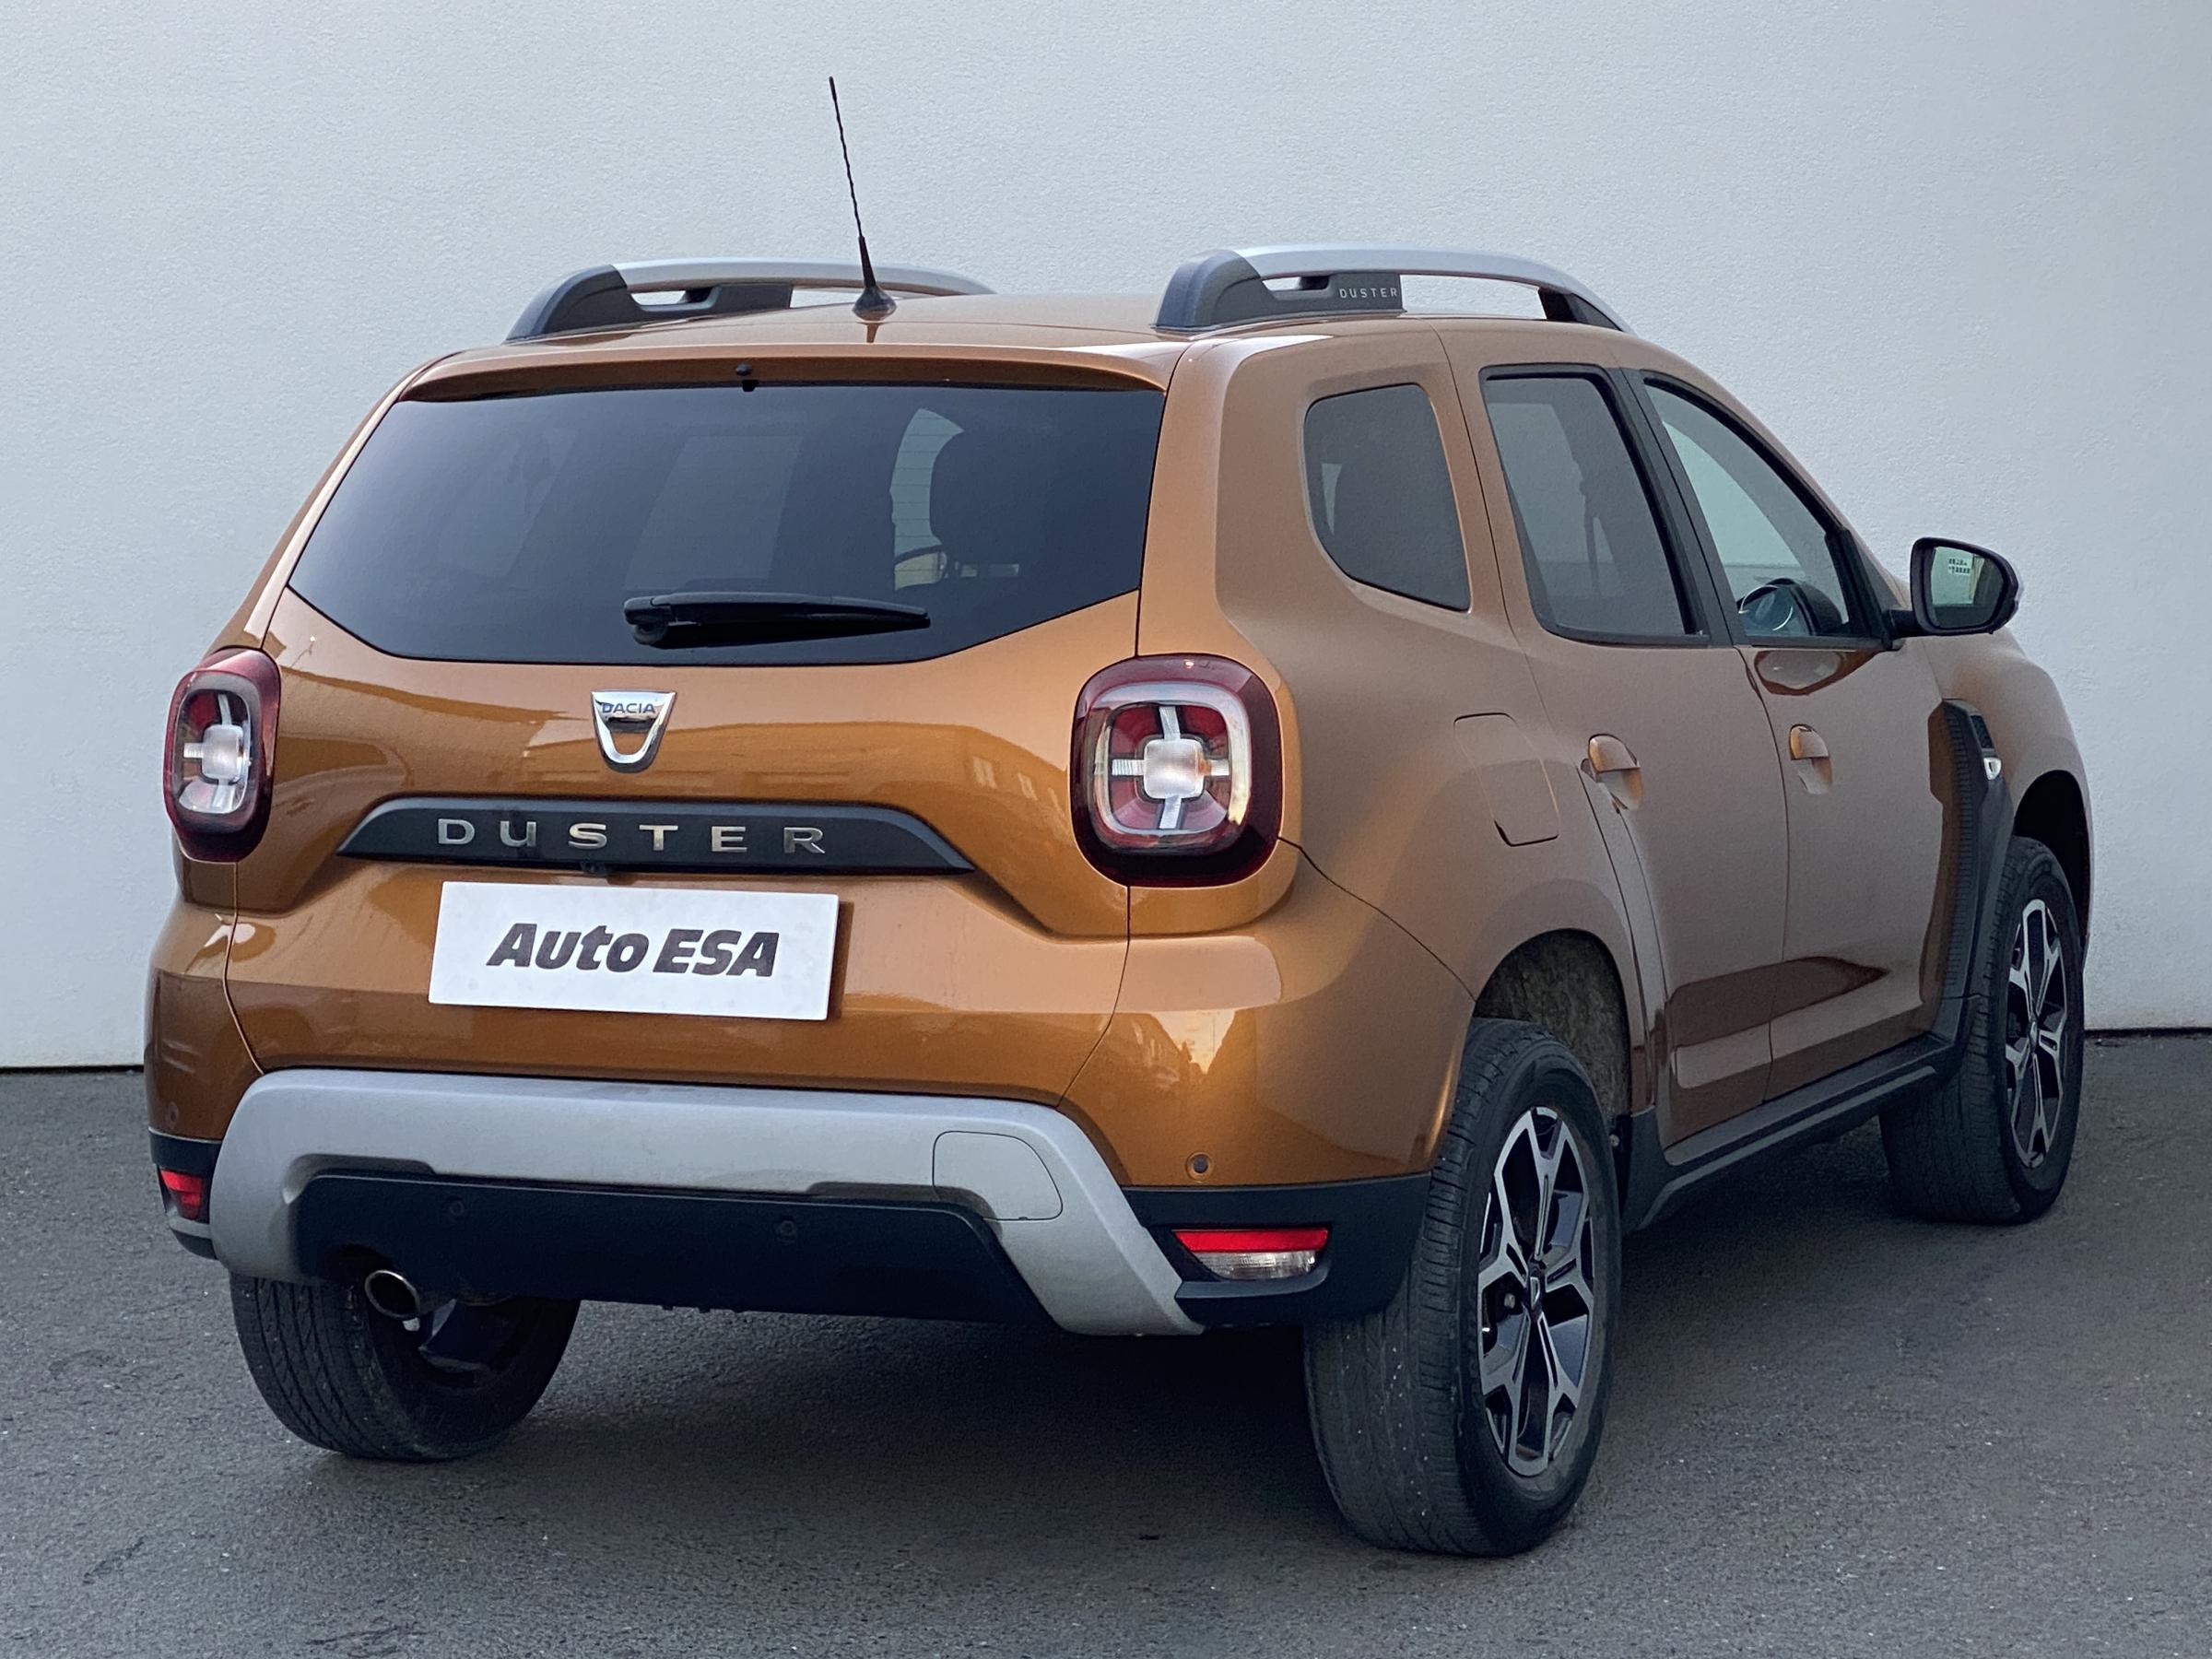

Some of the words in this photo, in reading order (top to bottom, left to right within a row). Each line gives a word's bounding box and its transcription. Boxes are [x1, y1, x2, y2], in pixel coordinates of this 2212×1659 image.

[1339, 288, 1397, 299] DUSTER
[602, 702, 655, 713] DACIA
[437, 818, 826, 854] DUSTER
[486, 922, 650, 973] Auto
[653, 928, 781, 978] ESA
